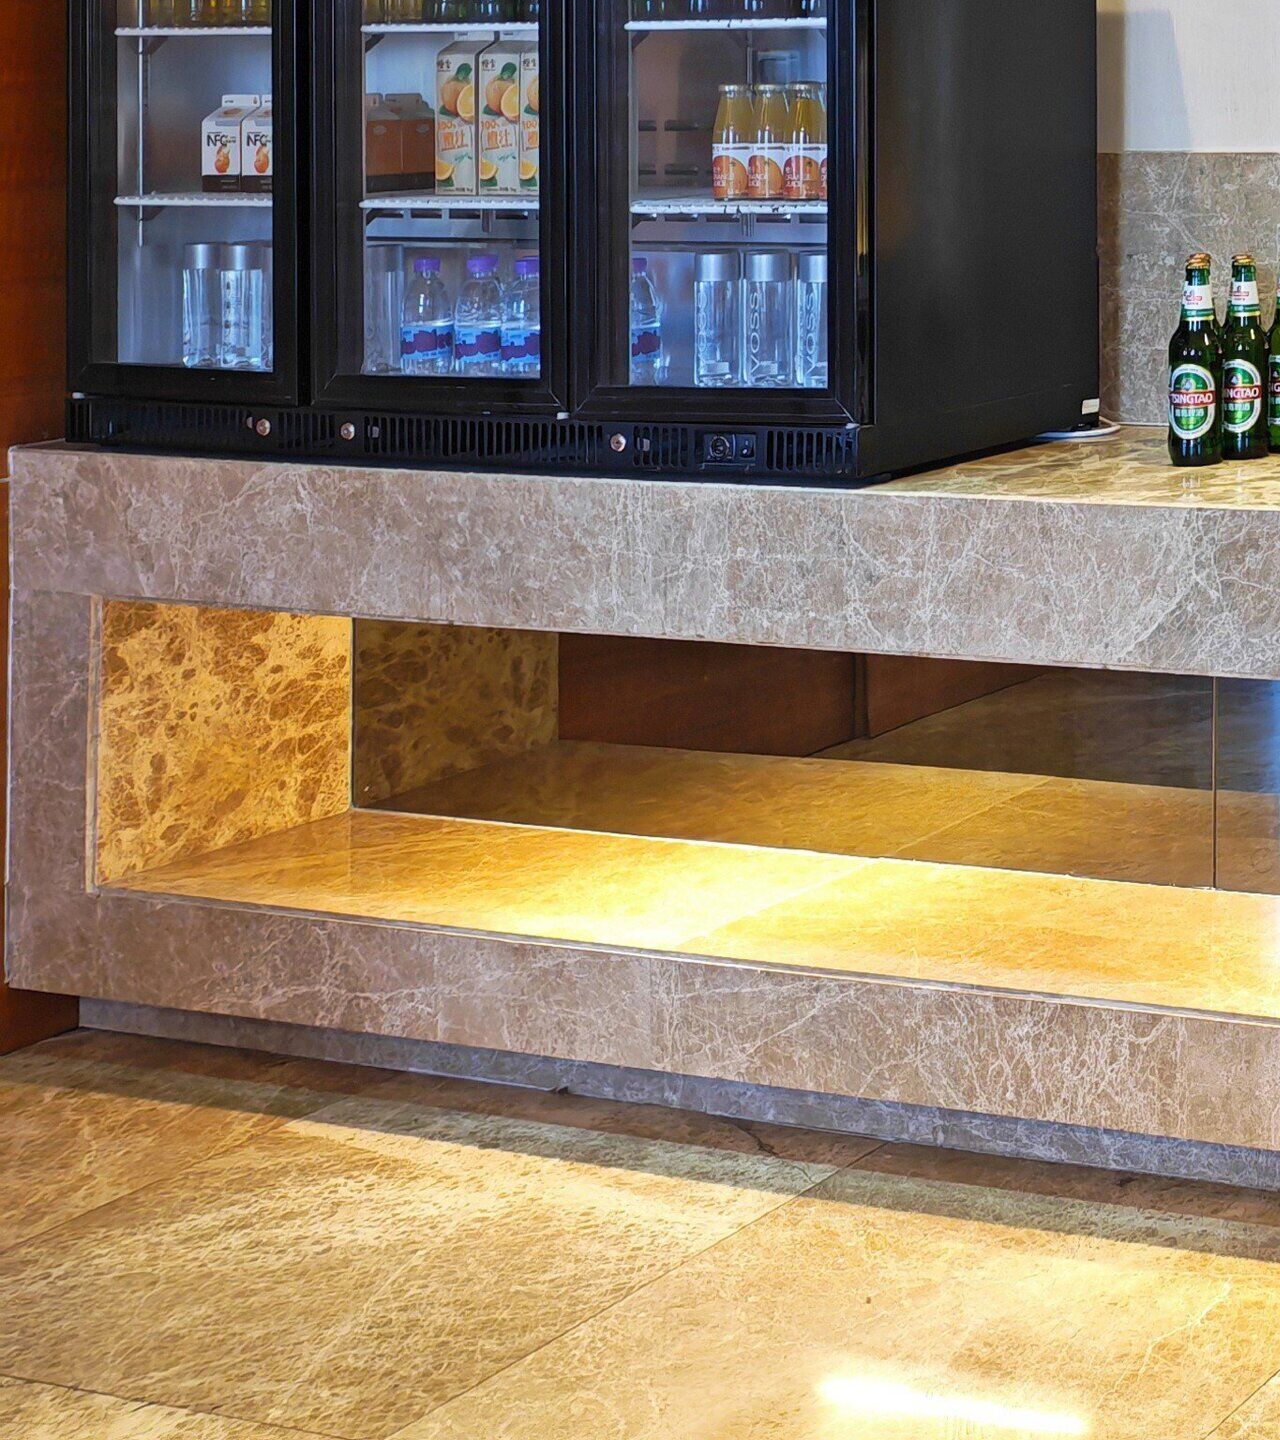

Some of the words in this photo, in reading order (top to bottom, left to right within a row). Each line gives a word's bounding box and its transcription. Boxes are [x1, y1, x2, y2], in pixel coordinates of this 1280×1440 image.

[749, 292, 760, 375] VOSS
[1169, 392, 1214, 406] TSINGTAO
[1227, 387, 1260, 399] NGTAO
